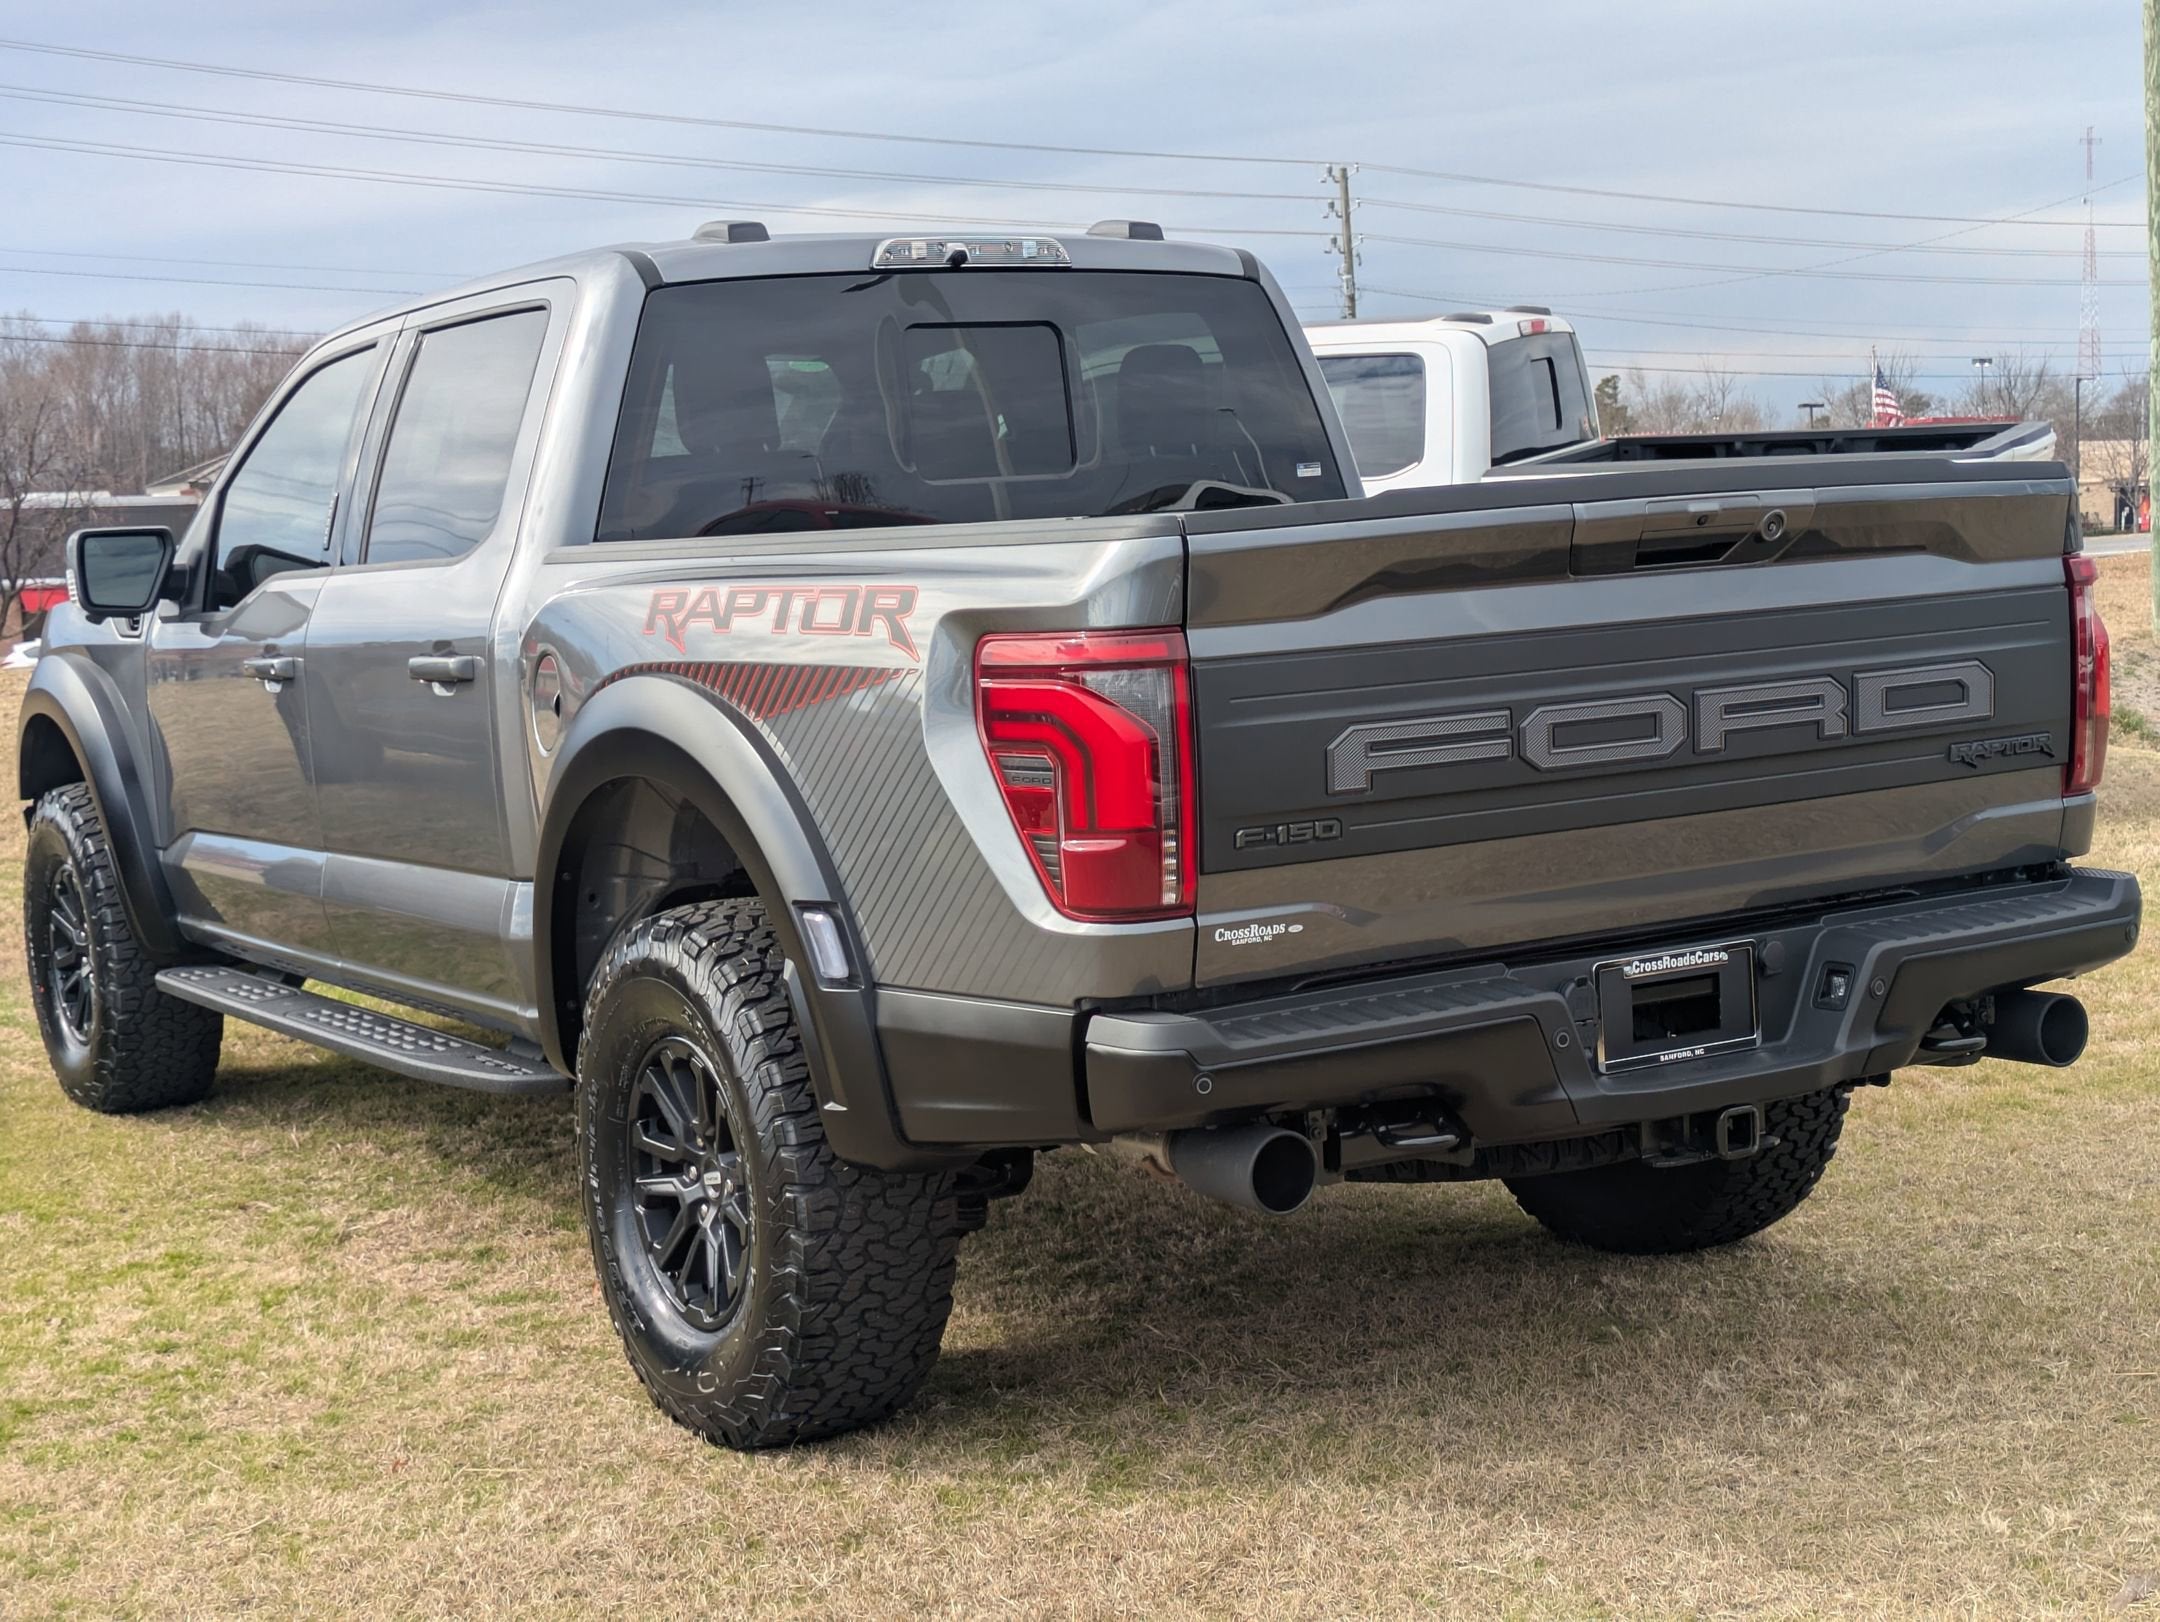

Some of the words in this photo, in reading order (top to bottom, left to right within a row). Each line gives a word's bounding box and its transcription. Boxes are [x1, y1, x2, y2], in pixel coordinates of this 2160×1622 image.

[641, 585, 920, 663] RAPTOR
[1326, 659, 1994, 795] FORD
[1949, 731, 2055, 769] RAPTOR
[1011, 776, 1052, 784] FORD
[1233, 817, 1342, 850] F-150
[1659, 1051, 1693, 1062] SANFORD,
[1695, 1048, 1704, 1056] NC
